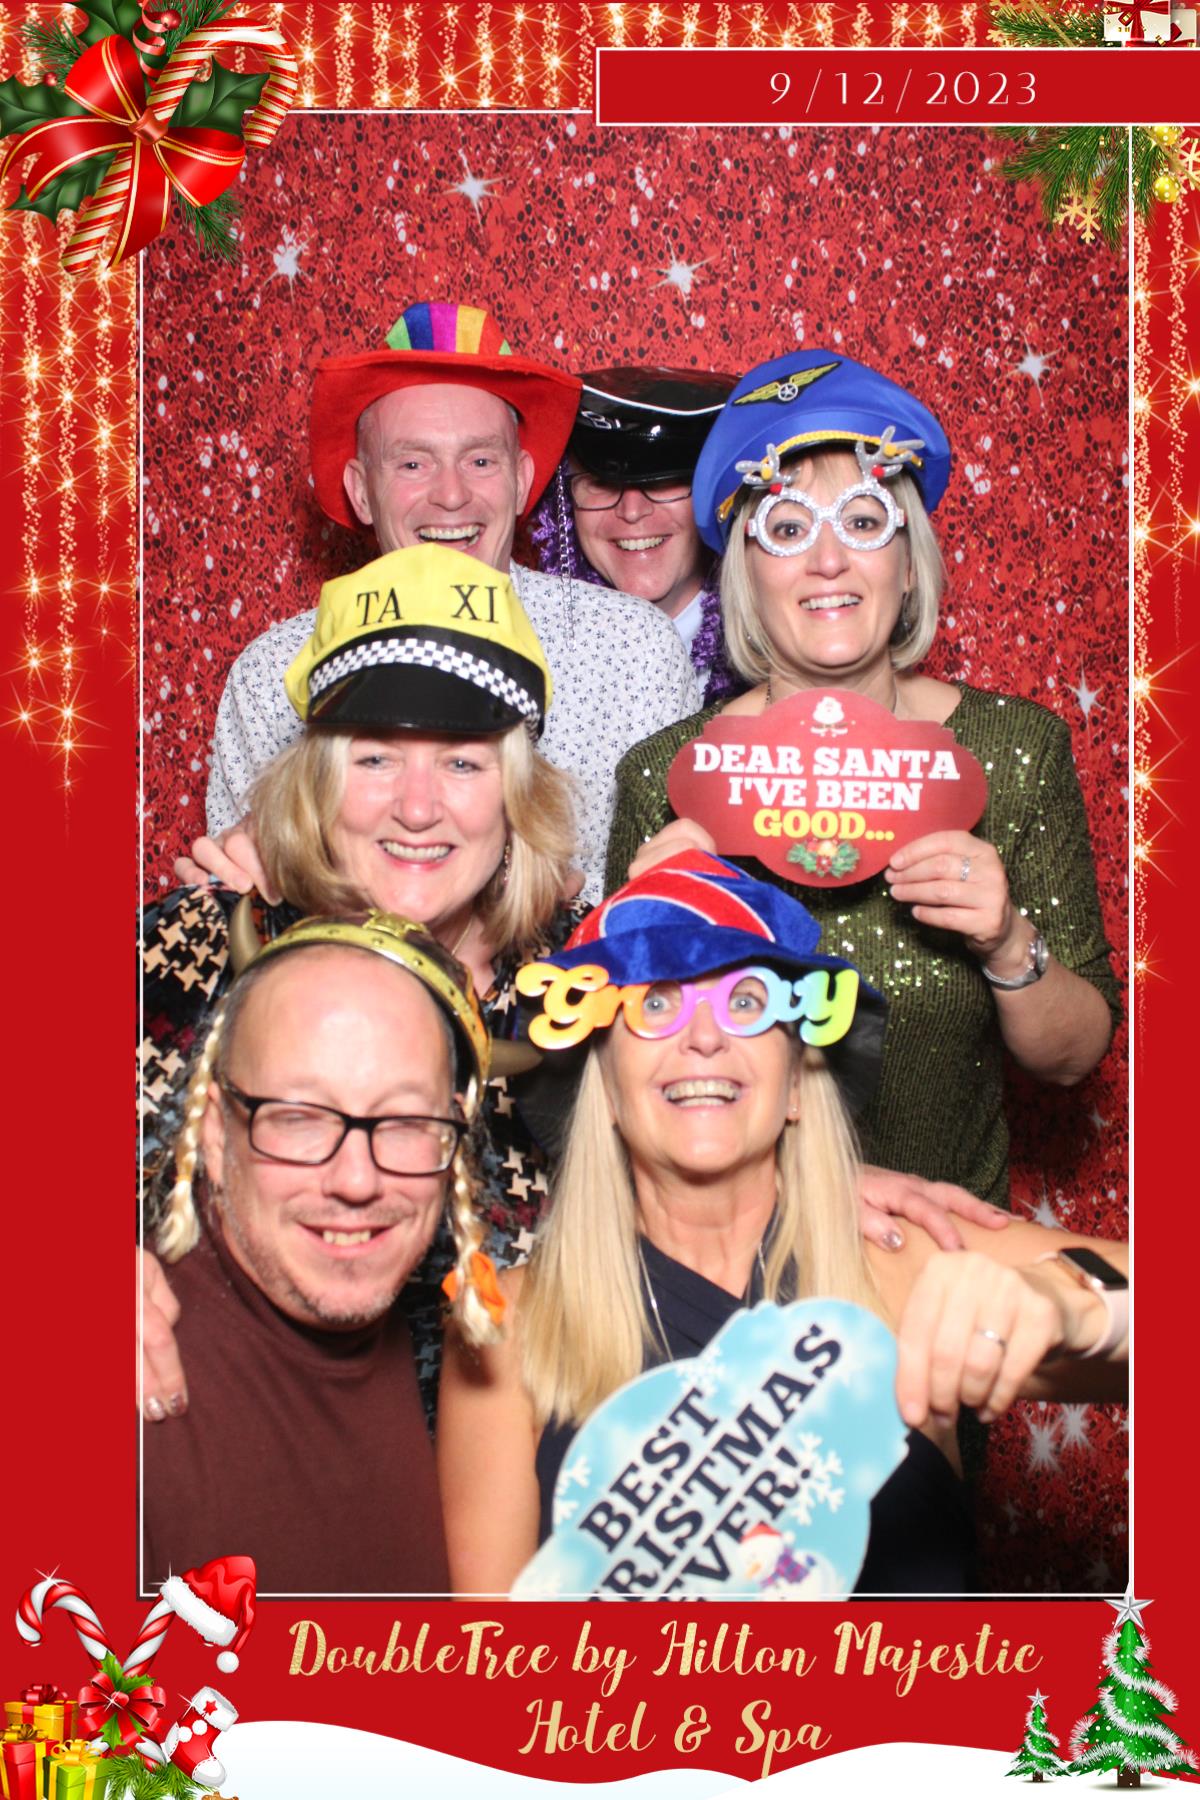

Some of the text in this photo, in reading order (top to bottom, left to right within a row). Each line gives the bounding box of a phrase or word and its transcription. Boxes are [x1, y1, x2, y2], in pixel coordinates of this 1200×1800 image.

[693, 743, 961, 780] DEAR SANTA
[727, 777, 924, 811] I'VE BEEN
[753, 808, 895, 842] GOOD...
[578, 1387, 719, 1553] BEST
[588, 1323, 843, 1601] RISTMAS
